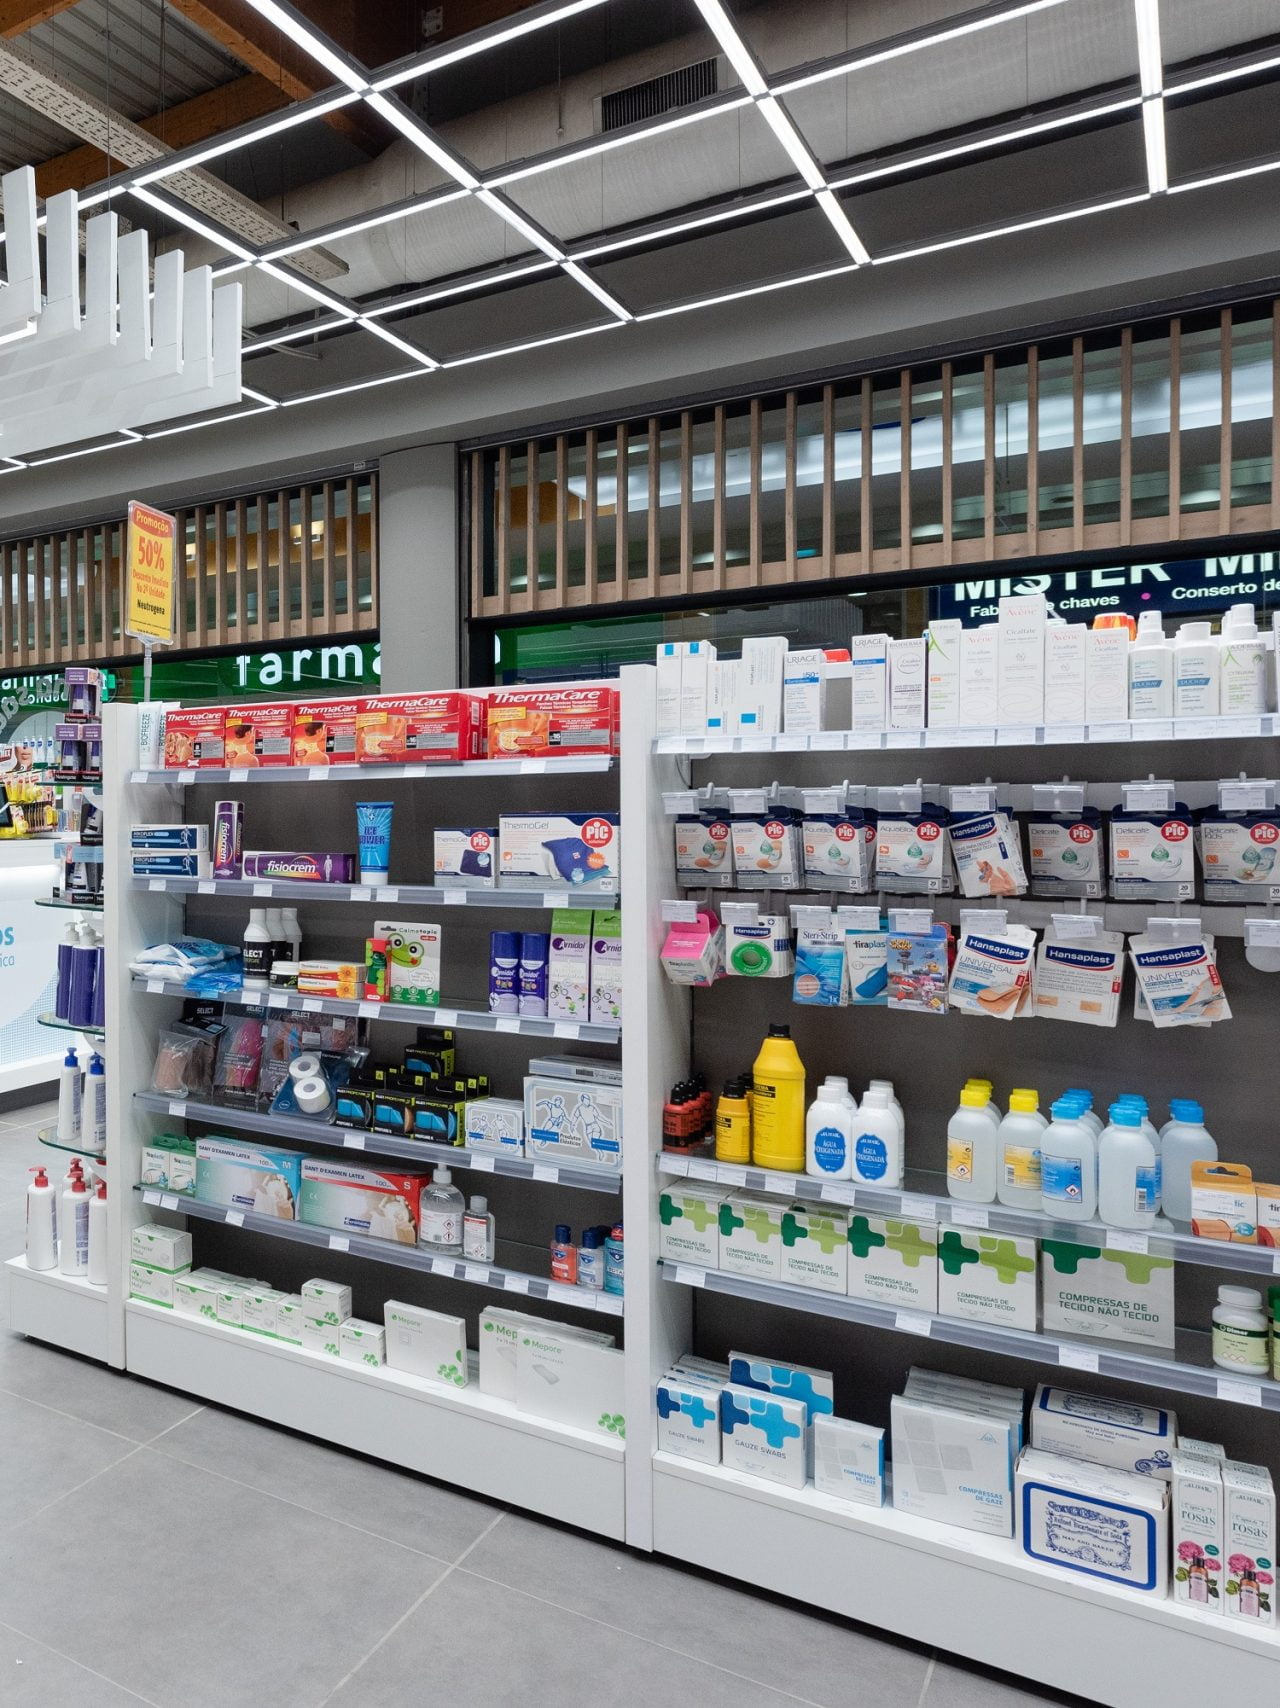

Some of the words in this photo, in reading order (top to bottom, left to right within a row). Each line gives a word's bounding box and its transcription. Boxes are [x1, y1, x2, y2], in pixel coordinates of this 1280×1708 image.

[136, 510, 169, 534] Promoção
[138, 536, 165, 572] 50%
[1204, 552, 1280, 577] MI
[1059, 594, 1121, 610] chaves
[1172, 581, 1257, 599] Conserto
[137, 599, 166, 615] Neutrogena
[365, 697, 449, 710] ThermaCare
[494, 690, 600, 704] ThermaCare
[167, 712, 222, 722] ThermaCare
[228, 708, 289, 718] ThermaCare
[364, 826, 377, 835] ICE
[504, 822, 549, 830] ThermoGel
[952, 821, 994, 839] Hansaplast
[220, 822, 230, 863] fisiocrem
[267, 860, 316, 874] fisiocrem
[803, 931, 838, 940] Steri-Strip
[970, 939, 1024, 956] Hansaplast
[1049, 949, 1110, 964] Hansaplast
[1140, 949, 1200, 964] Hansaplast
[960, 956, 1014, 975] UNIVERSAL
[1143, 968, 1204, 983] UNIVERSAL
[235, 1152, 250, 1160] LATEX
[282, 1161, 292, 1169] M
[348, 1172, 365, 1181] LATEX
[403, 1181, 411, 1190] S
[666, 1236, 697, 1247] COMPRESSAS
[666, 1240, 682, 1249] TECIDO
[694, 1246, 711, 1254] TECIDO
[726, 1247, 759, 1258] COMPRESSAS
[726, 1251, 743, 1261] TECIDO
[755, 1257, 774, 1266] TECIDO
[788, 1258, 823, 1270] COMPRESSAS
[789, 1263, 806, 1272] TECIDO
[820, 1269, 839, 1278] TECIDO
[865, 1274, 902, 1286] COMPRESSAS
[865, 1279, 883, 1289] TECIDO
[898, 1286, 918, 1294] TECIDO
[957, 1291, 998, 1304] COMPRESSAS
[957, 1297, 977, 1307] TECIDO
[994, 1304, 1016, 1312] TECIDO
[1060, 1291, 1130, 1310] COMPRESSAS
[1059, 1300, 1094, 1315] TECIDO
[1123, 1310, 1159, 1323] TECIDO
[496, 1325, 517, 1339] Mep
[532, 1340, 562, 1353] Mepore
[735, 1440, 759, 1453] GAUZE
[761, 1446, 786, 1460] SWABS
[959, 1486, 1003, 1500] COMPRESSAS
[987, 1496, 1003, 1505] GAZE
[1181, 1510, 1216, 1525] rosas
[1233, 1523, 1268, 1538] rosas
